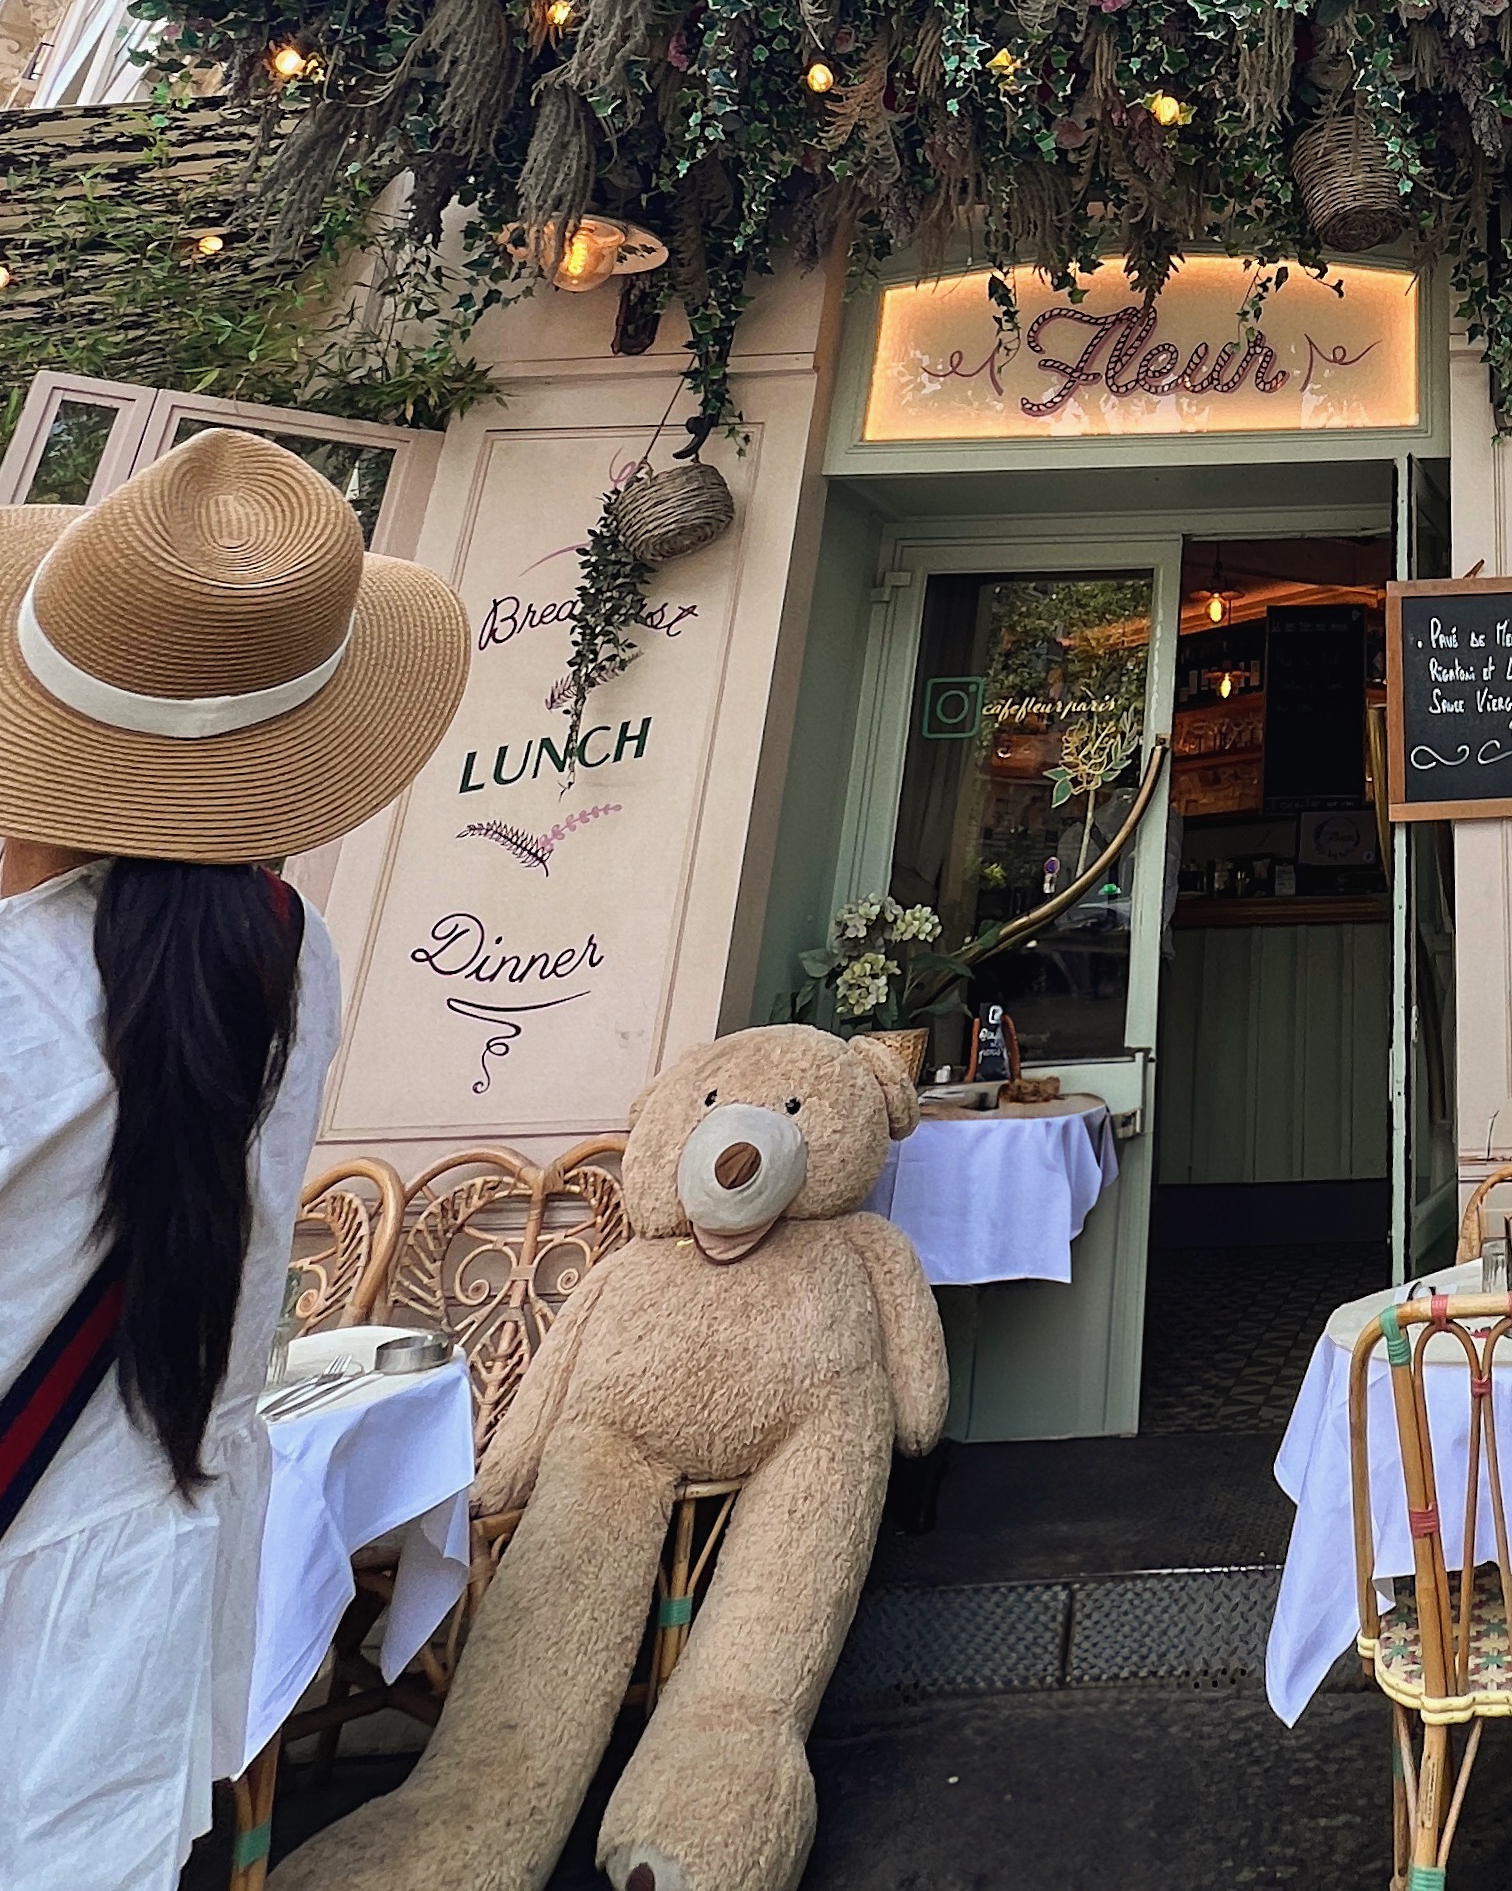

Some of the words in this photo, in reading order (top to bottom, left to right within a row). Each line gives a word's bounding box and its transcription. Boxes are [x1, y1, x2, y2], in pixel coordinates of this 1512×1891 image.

[1020, 305, 1288, 418] Fleur
[1482, 655, 1497, 682] et
[458, 716, 653, 794] LUNCH
[411, 912, 605, 984] Dinner
